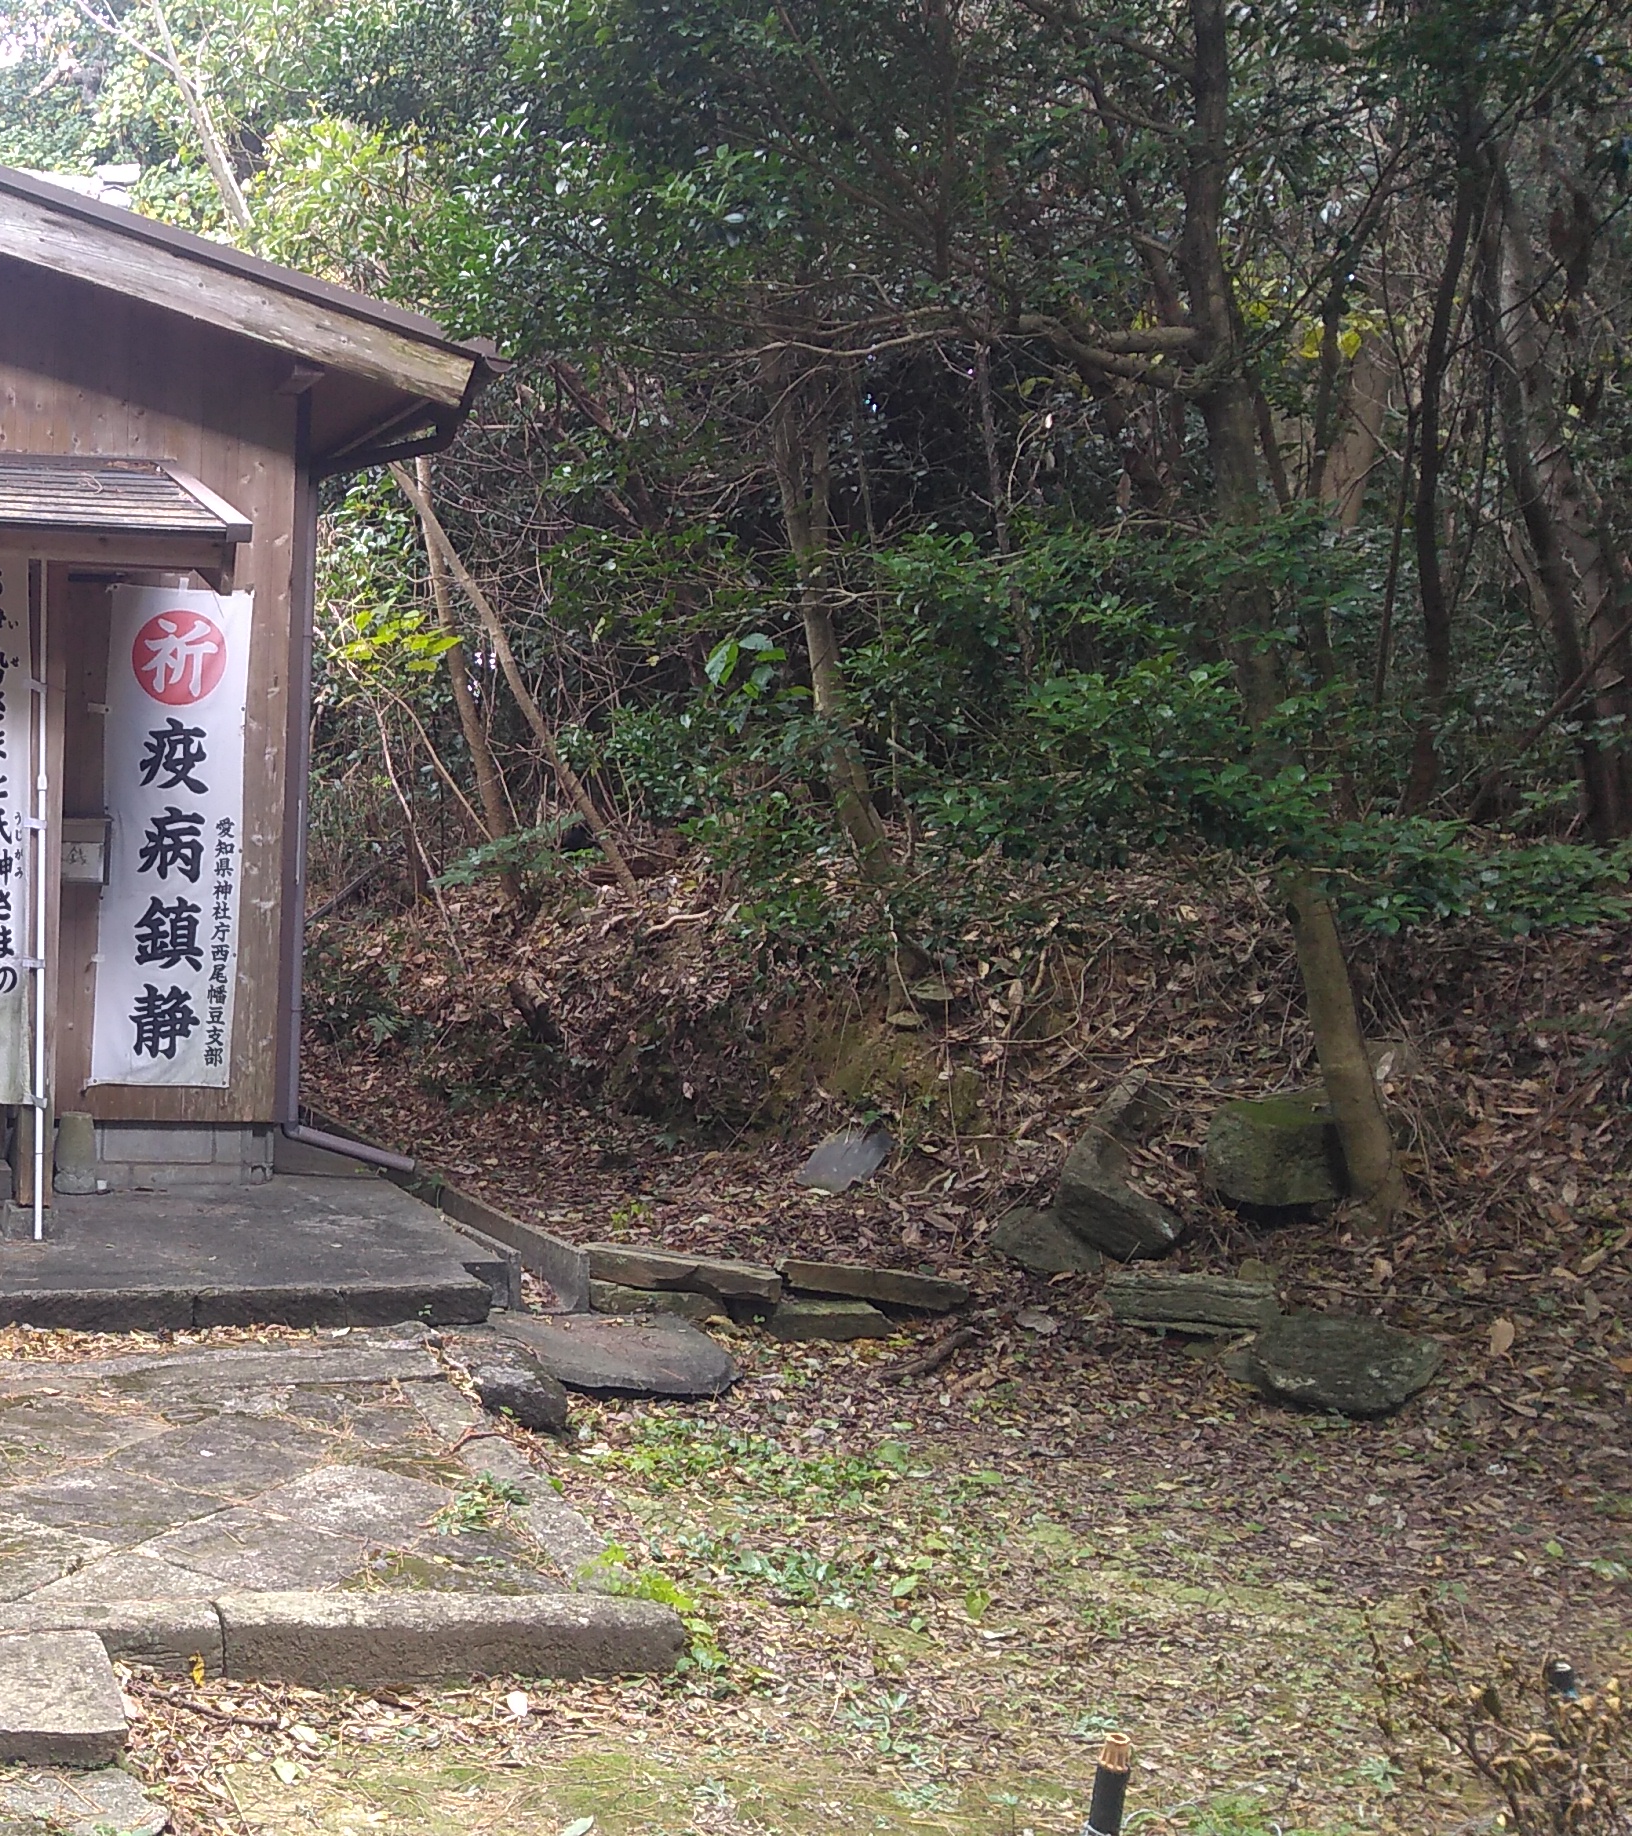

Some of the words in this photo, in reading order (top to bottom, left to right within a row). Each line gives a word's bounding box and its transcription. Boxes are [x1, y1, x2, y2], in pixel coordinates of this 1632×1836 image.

[7, 621, 20, 668] いせ
[141, 617, 219, 698] 祈
[128, 716, 210, 1060] 疫病鎮静
[203, 816, 236, 1068] 愛知県神社庁西尾幡豆支部
